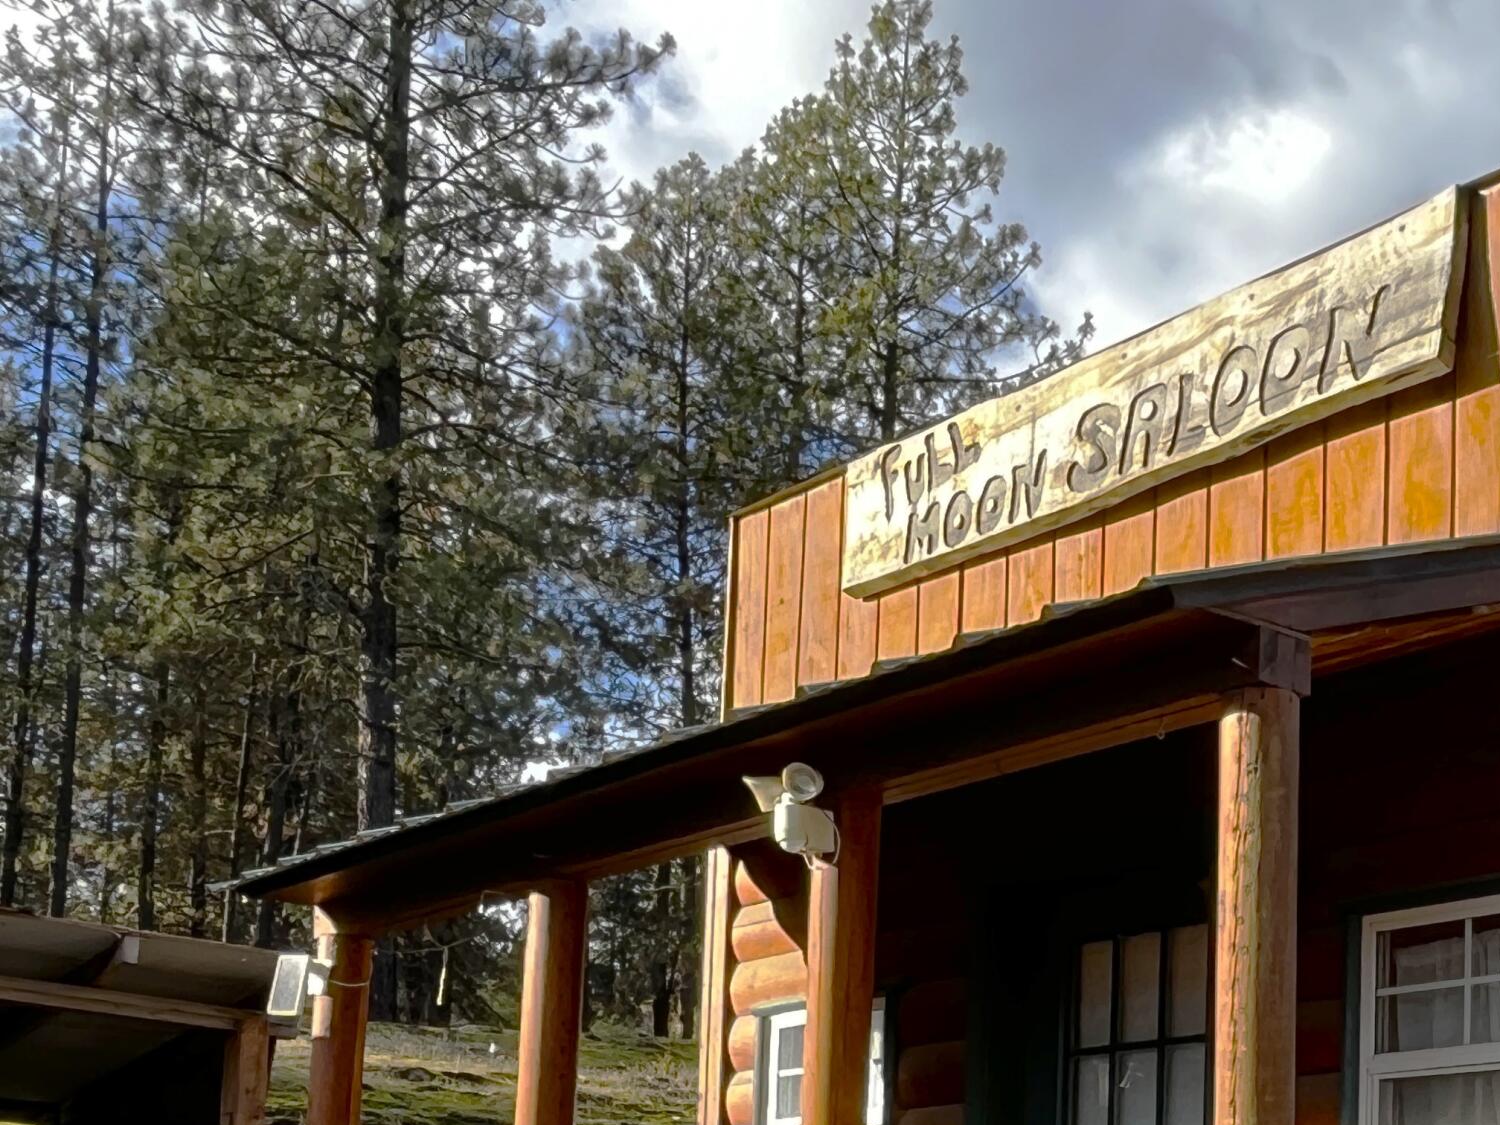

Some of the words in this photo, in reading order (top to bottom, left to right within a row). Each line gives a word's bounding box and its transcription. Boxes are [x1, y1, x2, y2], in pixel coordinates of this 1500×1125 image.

[881, 421, 981, 521] FULL
[902, 448, 1048, 564] MOON
[1066, 284, 1391, 491] SALOON
